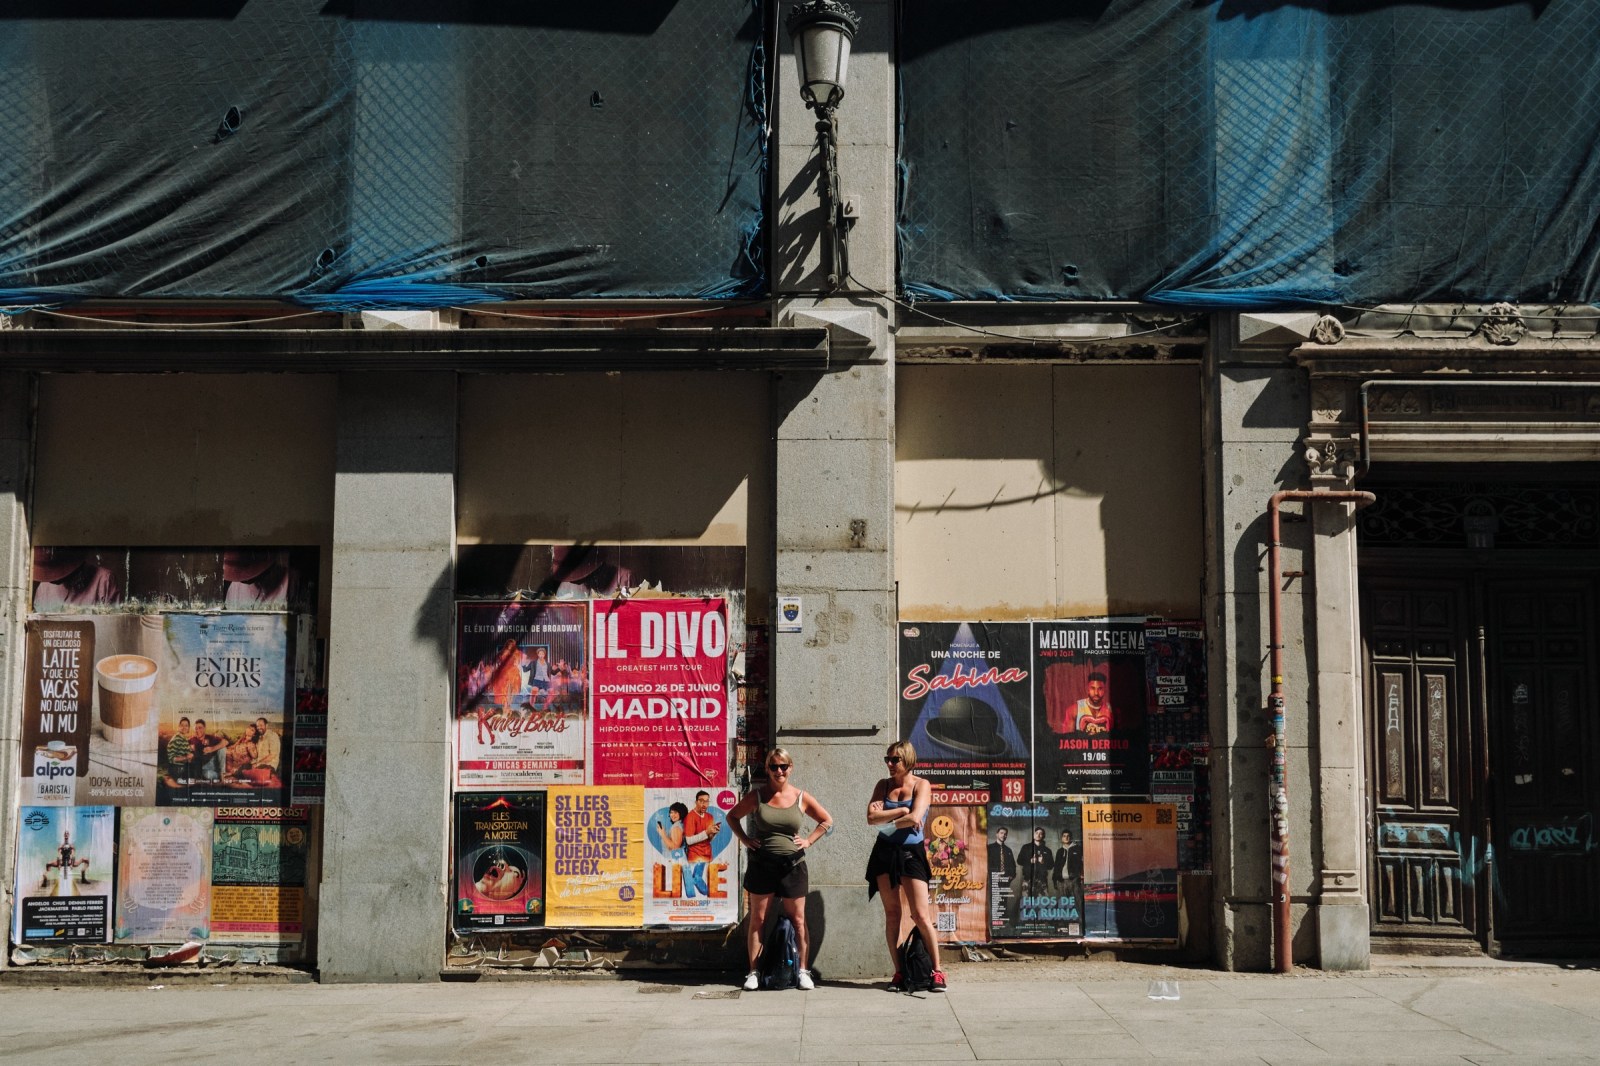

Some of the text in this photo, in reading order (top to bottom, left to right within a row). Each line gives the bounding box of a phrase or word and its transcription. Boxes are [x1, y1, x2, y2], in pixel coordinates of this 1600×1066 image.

[464, 624, 472, 632] EL
[474, 624, 495, 632] ÉXITO
[498, 624, 528, 632] MUSICAL
[542, 624, 582, 632] BROADWAY
[596, 610, 725, 658] IL DIVO
[44, 639, 81, 647] UN DELICIOSO
[1040, 630, 1145, 649] MADRID ESCENA
[43, 648, 80, 668] LATTE
[196, 657, 261, 672] ENTRE
[42, 669, 78, 678] Y QUE LAS
[195, 672, 261, 688] COPAS
[600, 684, 720, 693] DOMINGO 26 DE JUNIO
[903, 663, 1028, 700] Sabina
[40, 680, 79, 698] VACAS
[40, 700, 78, 712] NO DIGAN
[600, 698, 721, 719] MADRID
[40, 714, 77, 733] NI MU
[477, 707, 570, 745] Kinky Boots
[1059, 739, 1128, 750] JASON DERULO
[1083, 752, 1106, 761] 19/06
[36, 765, 74, 780] alpro
[89, 777, 144, 787] 100% VEGETAL
[1006, 781, 1021, 794] 19
[40, 785, 68, 794] BARISTA
[555, 795, 609, 811] SI LEES
[951, 793, 989, 802] APOLO
[492, 812, 510, 821] ELES
[555, 811, 611, 827] ESTO ES
[1088, 810, 1142, 823] Lifetime
[474, 821, 528, 830] TRANSPORTAN
[484, 831, 518, 839] A MORTE
[555, 828, 628, 843] QUE NO TE
[555, 844, 627, 859] QUEDASTE
[555, 860, 604, 875] CIEGX.
[653, 862, 728, 898] LIKE
[943, 876, 984, 890] Flores
[1023, 896, 1075, 906] HIJOS DE
[1024, 908, 1079, 918] LA RUINA
